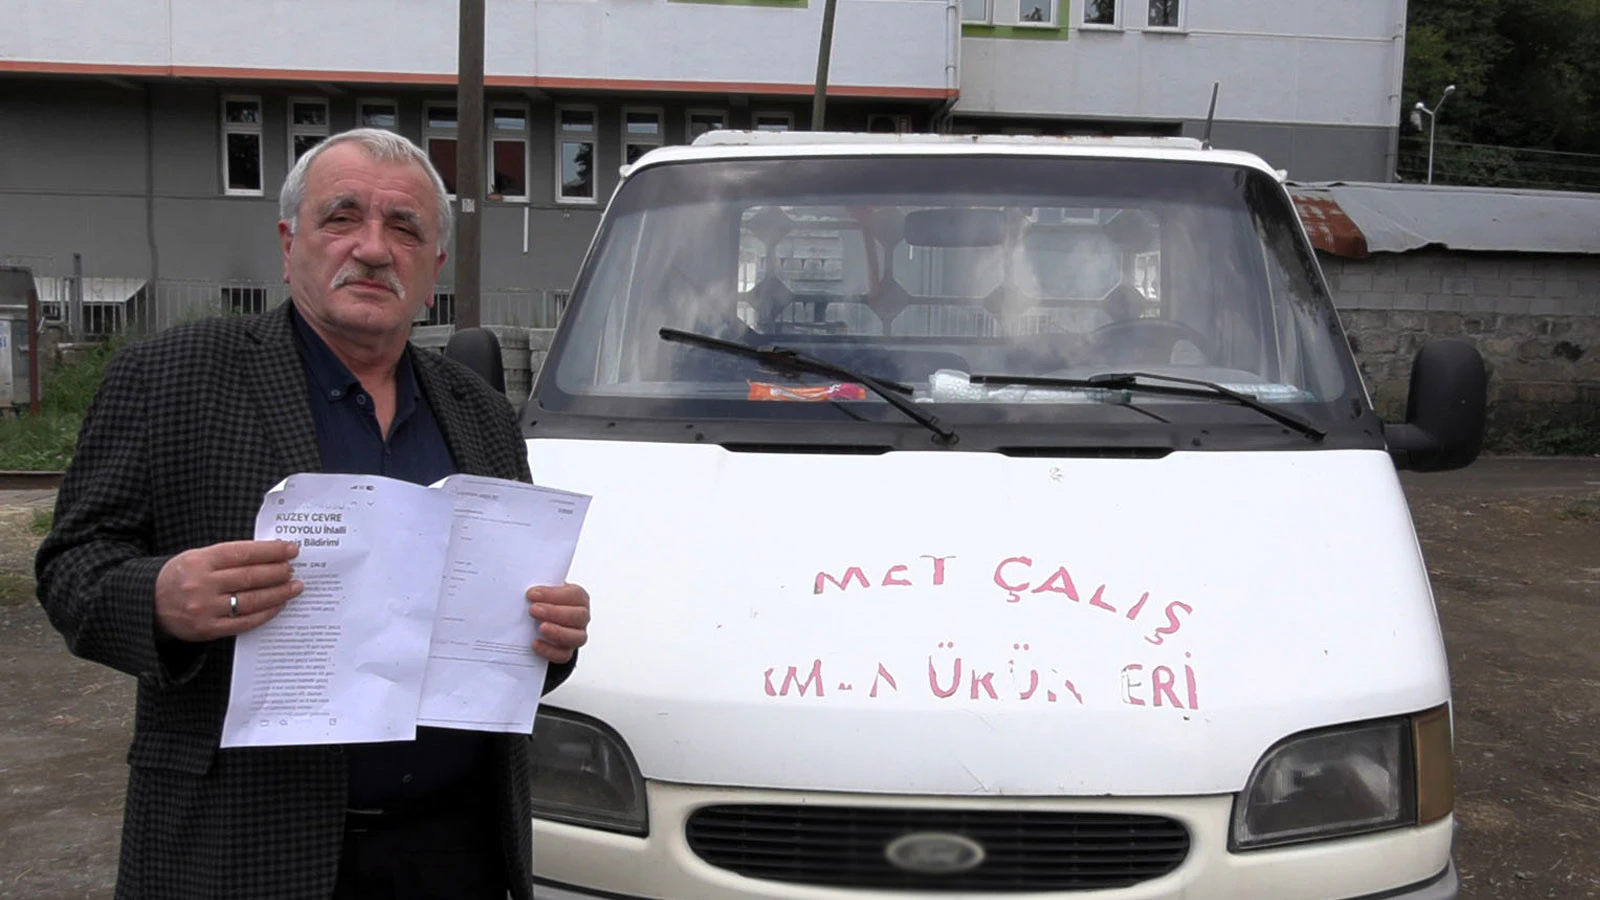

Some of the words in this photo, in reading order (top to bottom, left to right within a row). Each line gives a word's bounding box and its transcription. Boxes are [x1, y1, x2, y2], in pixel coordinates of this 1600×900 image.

[275, 513, 309, 522] KUZEY
[275, 525, 322, 534] OTOYOLU
[303, 538, 340, 547] Bildirimi
[993, 556, 1193, 645] ÇALIŞ
